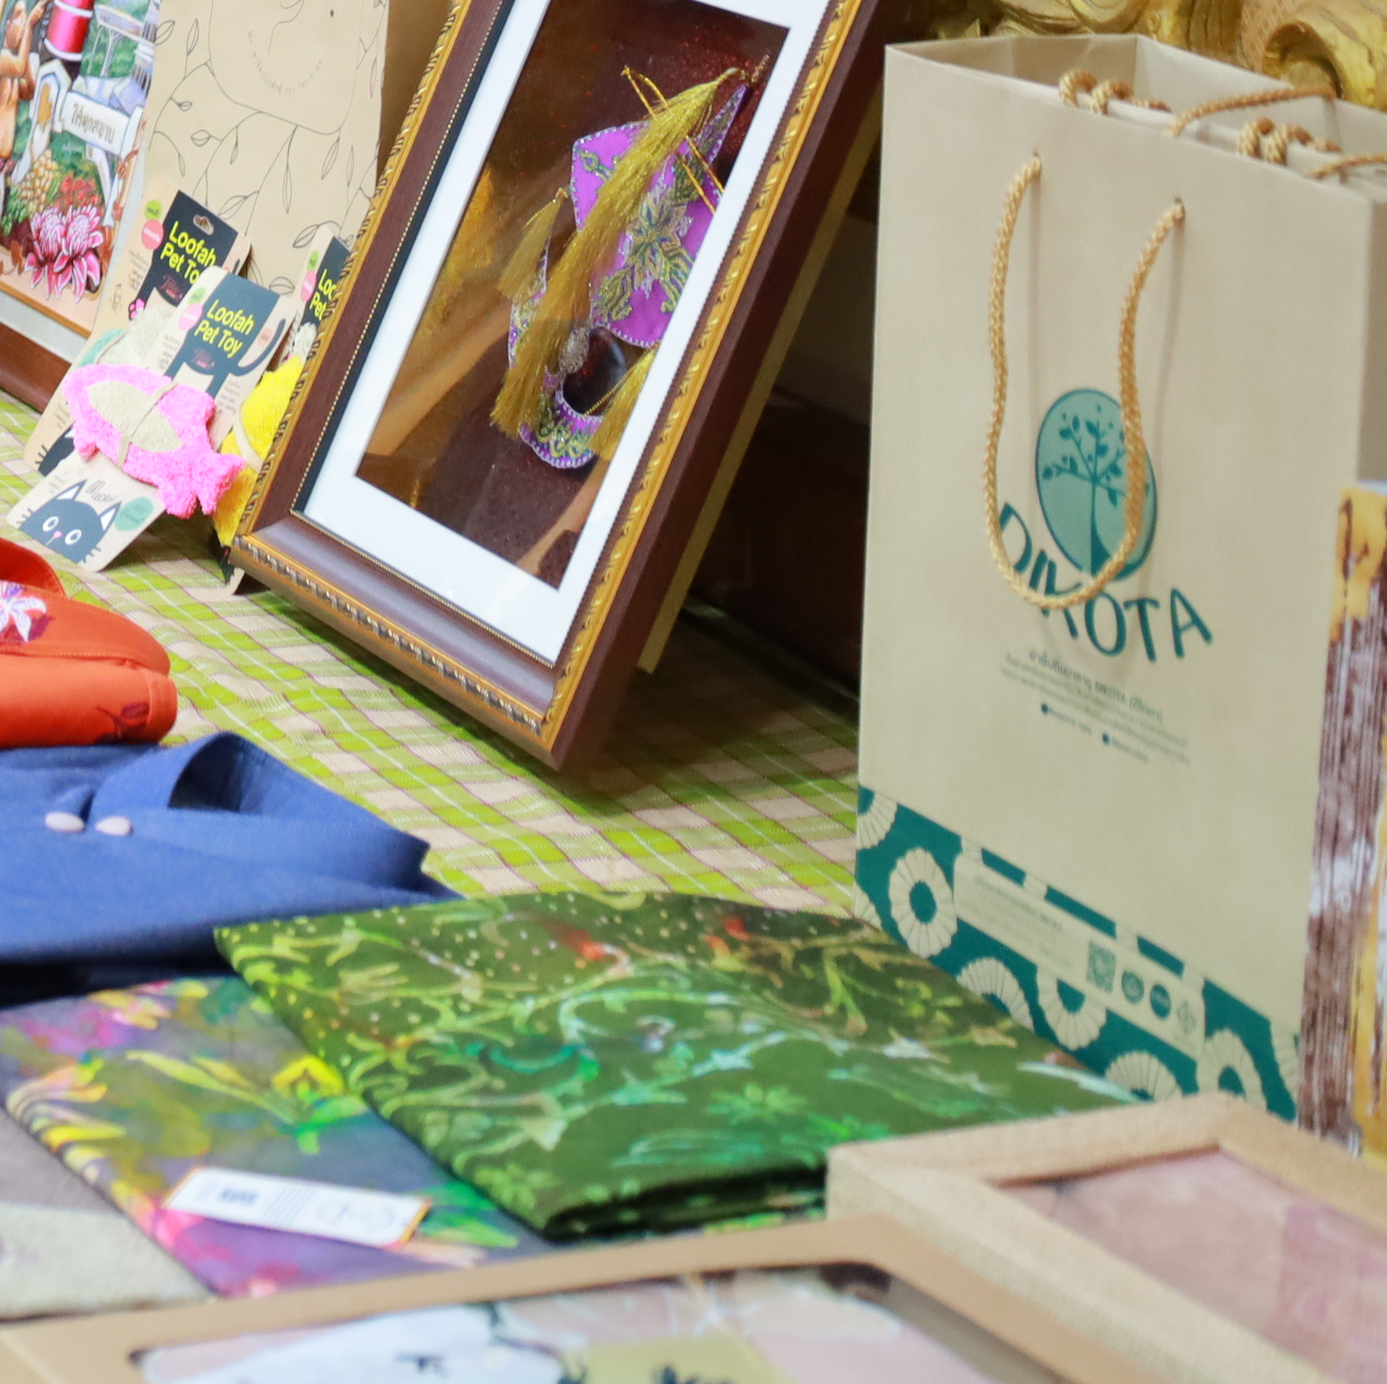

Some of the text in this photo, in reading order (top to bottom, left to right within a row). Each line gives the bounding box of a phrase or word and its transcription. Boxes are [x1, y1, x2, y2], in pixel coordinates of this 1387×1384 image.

[160, 242, 184, 273] Pet
[184, 259, 200, 285] To
[169, 220, 217, 267] Loofah
[206, 299, 255, 335] Loofah
[194, 320, 243, 358] Pet Toy
